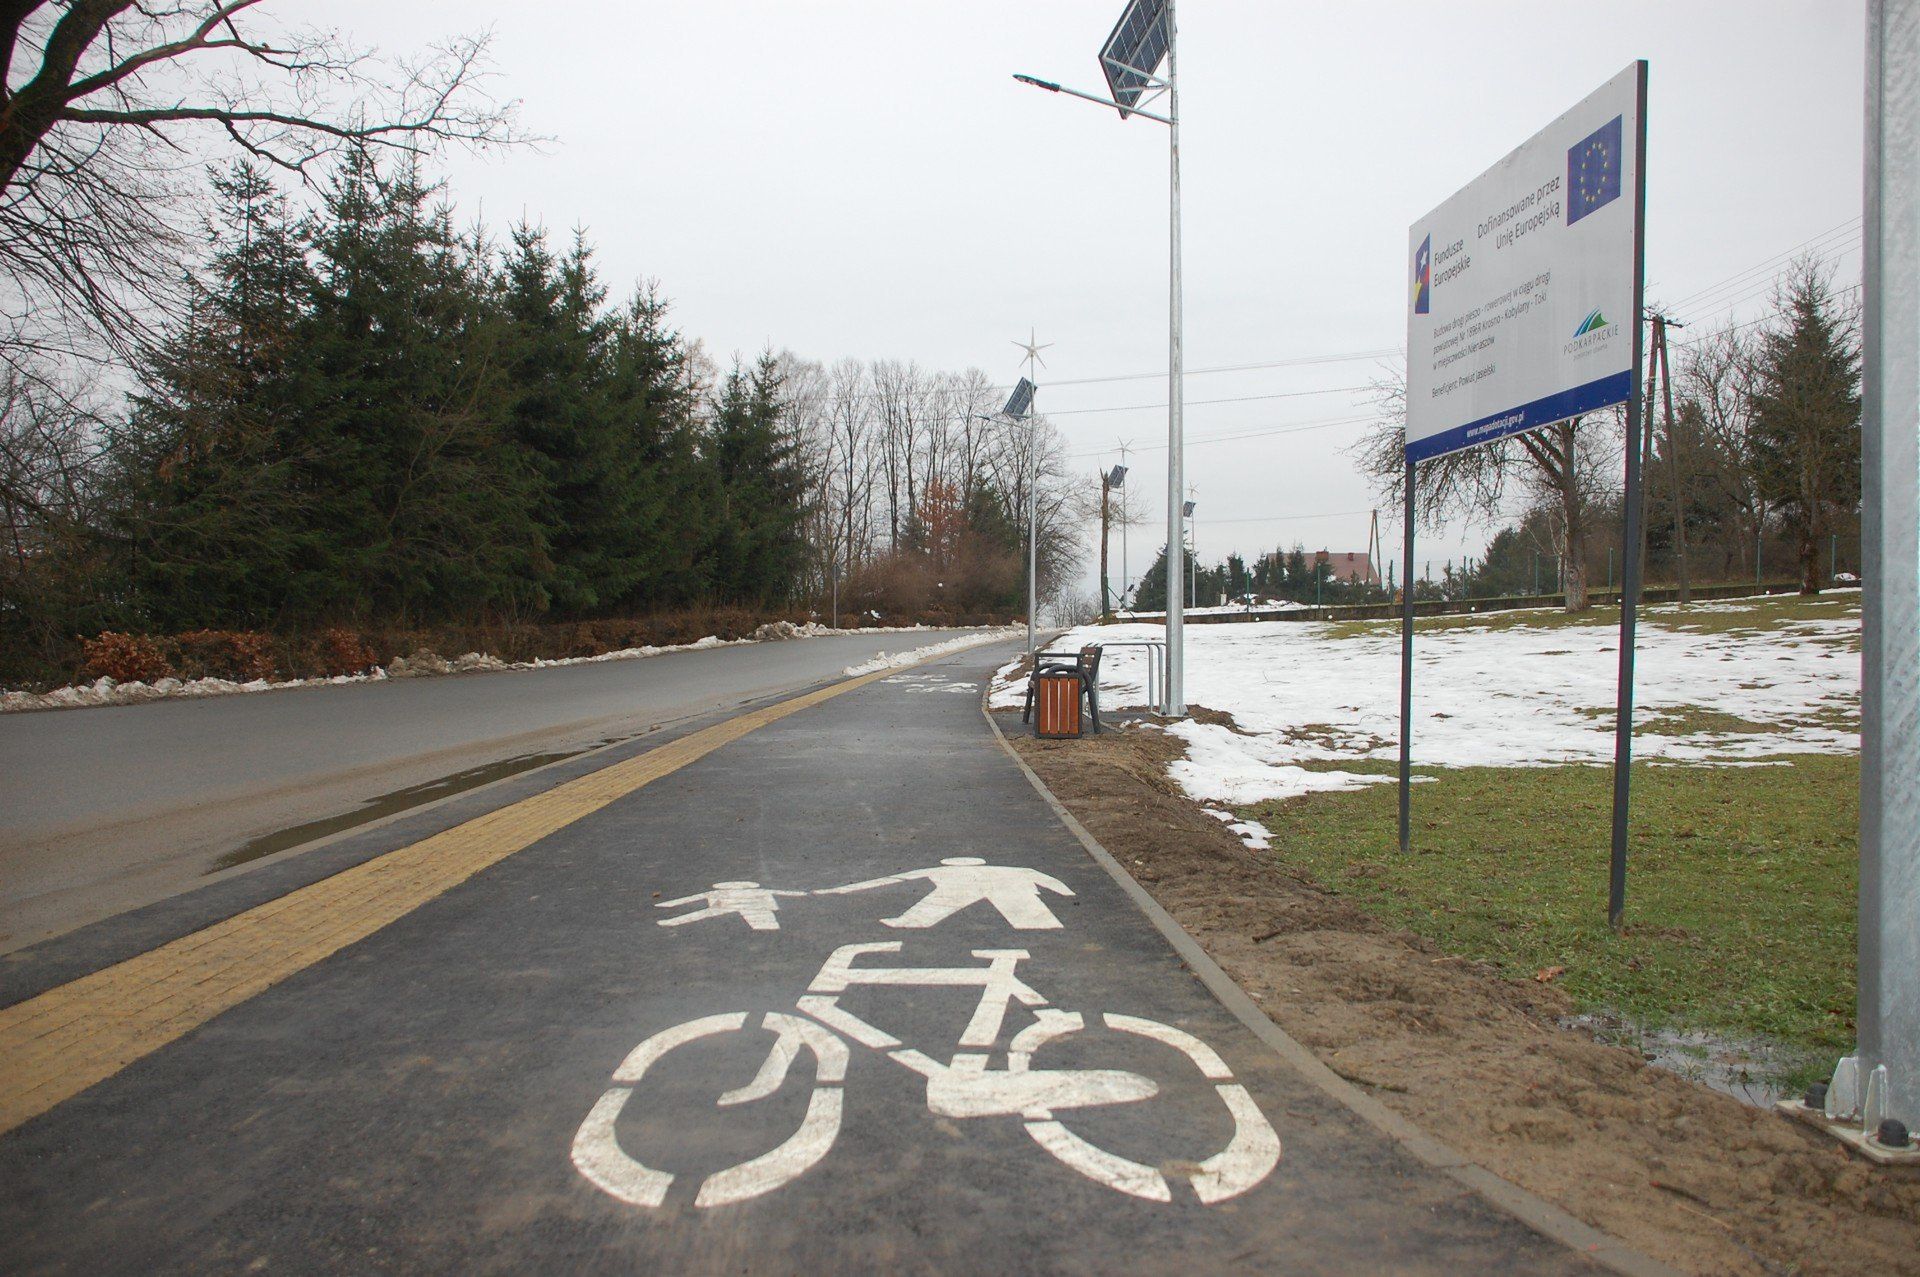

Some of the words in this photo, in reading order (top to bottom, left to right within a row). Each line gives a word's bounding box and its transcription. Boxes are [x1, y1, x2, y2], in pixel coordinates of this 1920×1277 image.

[1477, 193, 1535, 239] Dofinansowane
[1536, 176, 1560, 205] przez
[1496, 228, 1513, 250] Unię
[1515, 200, 1560, 239] Europejską
[1434, 239, 1464, 267] Fundusze
[1434, 254, 1471, 287] Europejskie
[1433, 323, 1452, 339] Budowa
[1452, 315, 1465, 330] drogi
[1465, 307, 1480, 326] pieszo
[1484, 289, 1512, 312] rowerowej
[1535, 269, 1551, 287] drogi
[1482, 315, 1500, 330] Krosno
[1563, 324, 1618, 355] PODKARPACKIE
